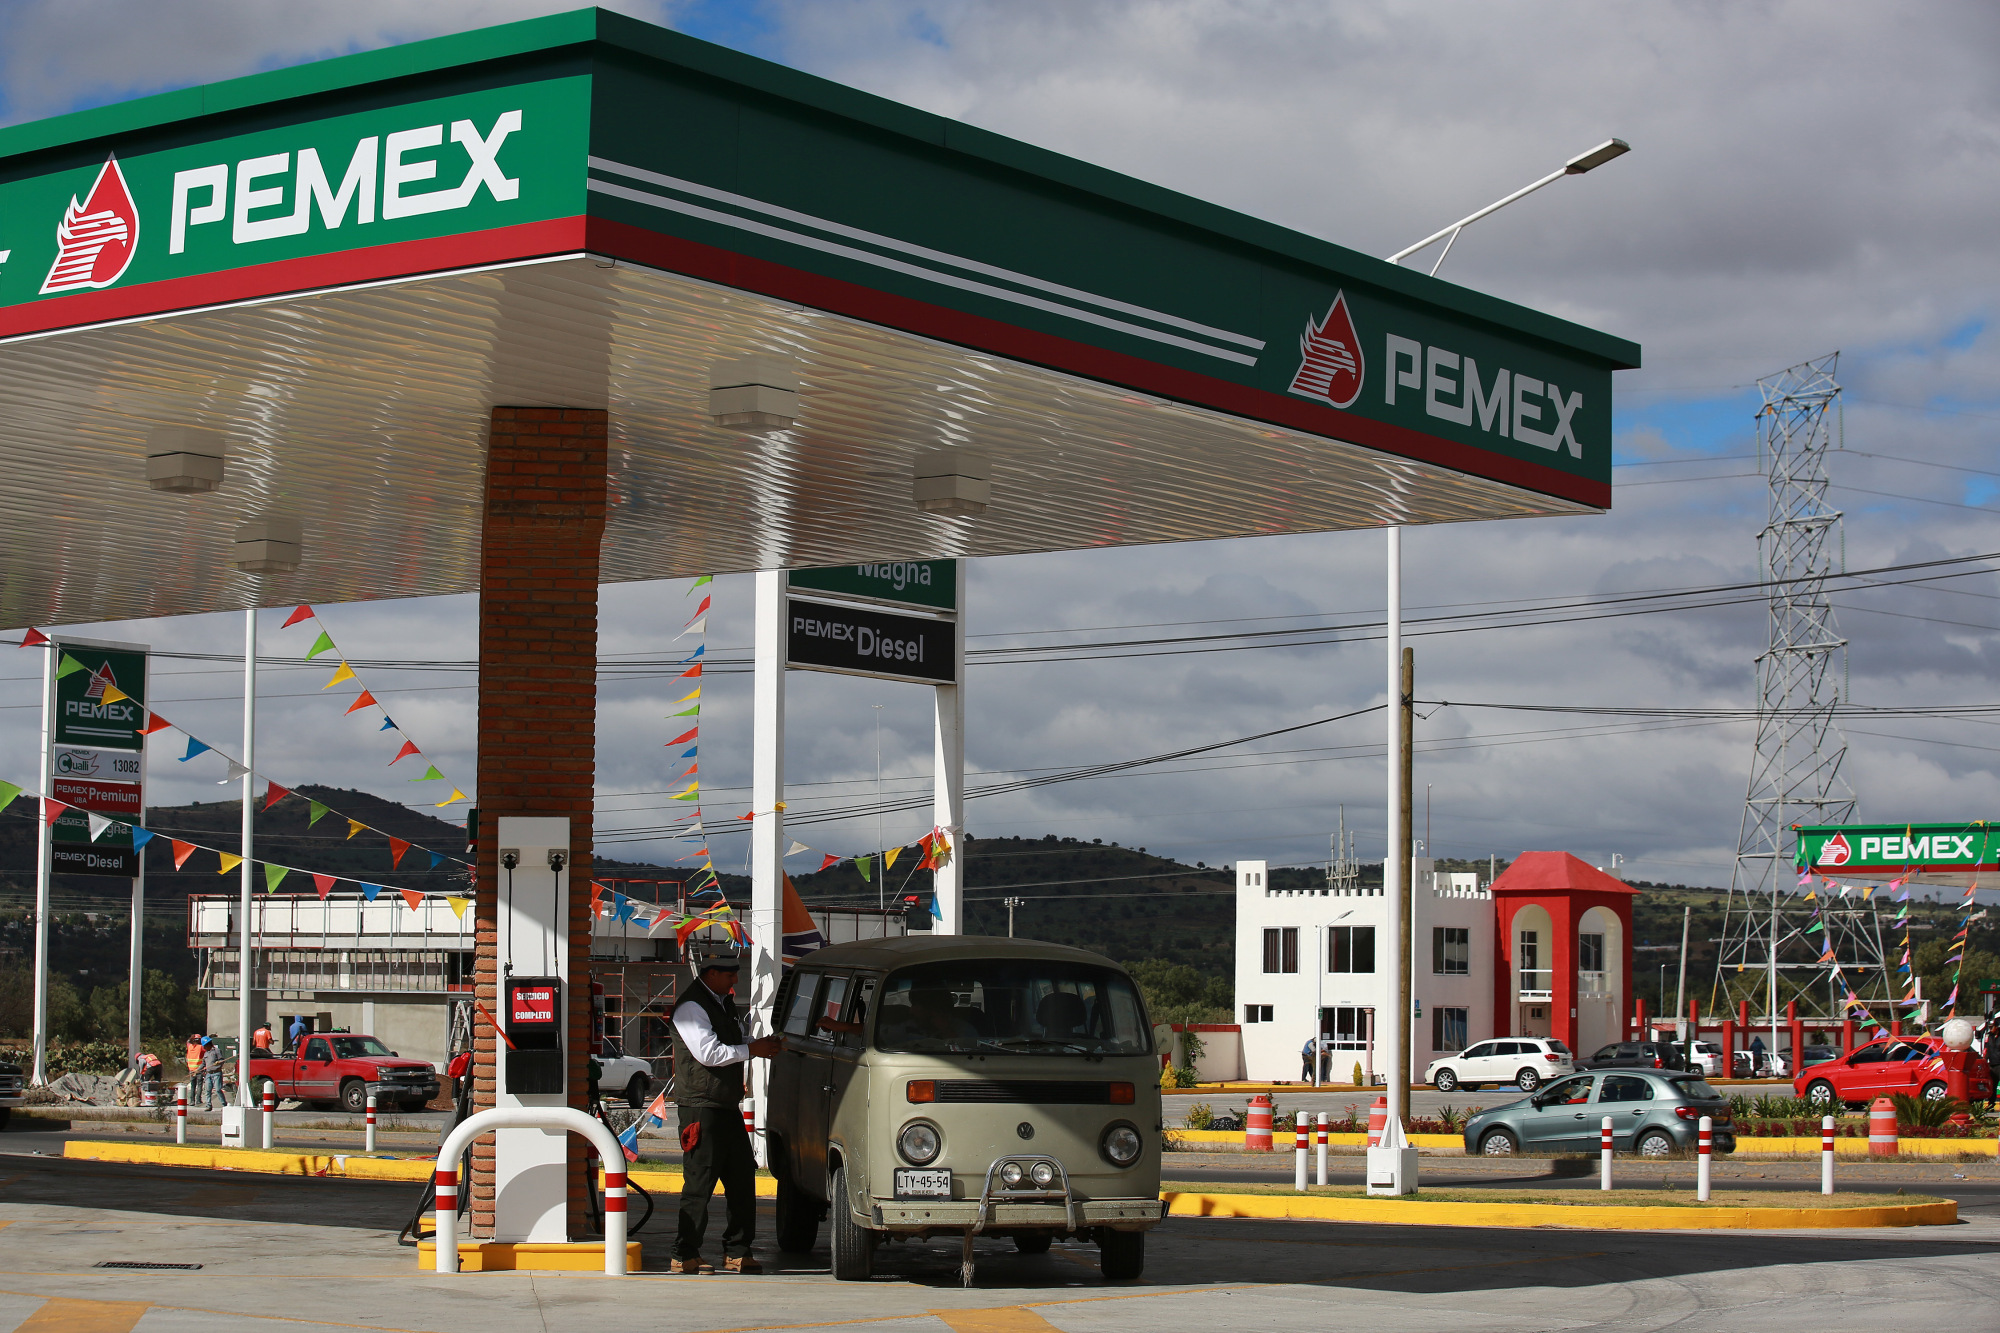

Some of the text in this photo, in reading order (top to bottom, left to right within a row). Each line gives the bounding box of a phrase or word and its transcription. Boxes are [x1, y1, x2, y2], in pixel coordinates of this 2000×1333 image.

[169, 110, 523, 255] PEMEX
[1385, 332, 1583, 460] PEMEX
[793, 617, 924, 663] PEMEX Diesel
[65, 700, 134, 721] PEMEX
[113, 759, 139, 774] 13082
[56, 784, 139, 803] PEMEX Premium
[1860, 835, 1974, 860] PEMEX
[54, 851, 123, 869] PEMEX Diesel
[516, 992, 549, 1000] SERVICIO
[515, 1011, 551, 1019] COMPLETO
[898, 1175, 948, 1188] LTY-45-54
